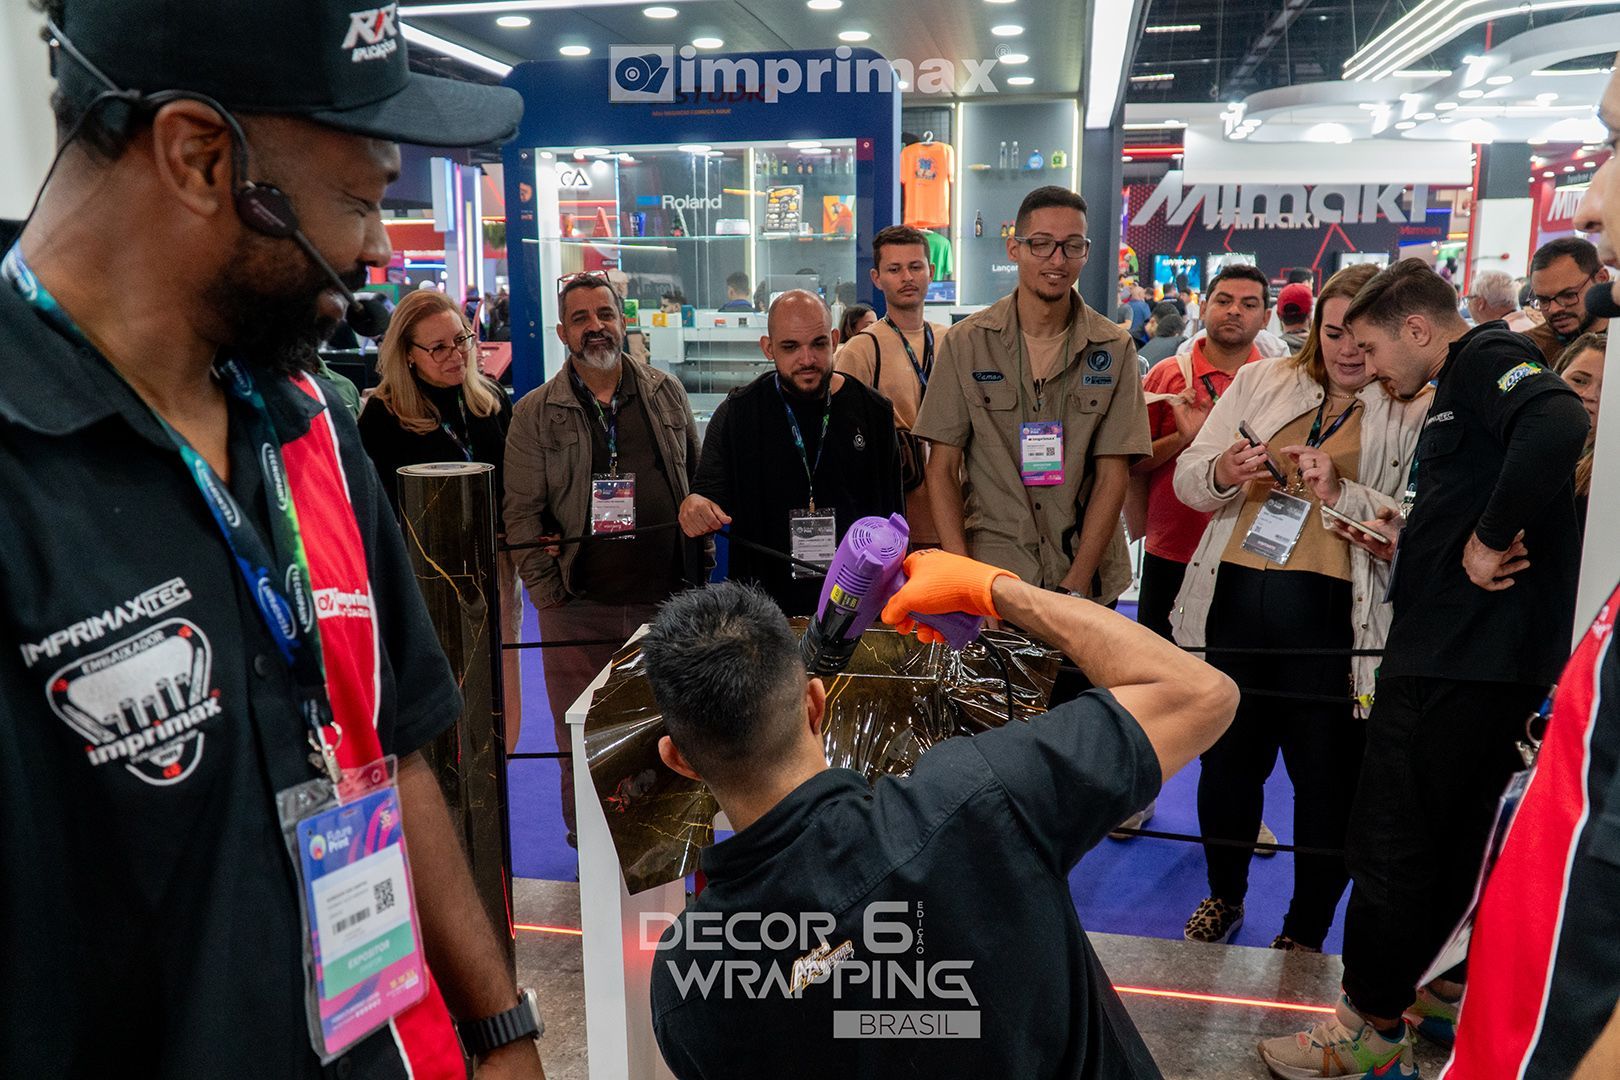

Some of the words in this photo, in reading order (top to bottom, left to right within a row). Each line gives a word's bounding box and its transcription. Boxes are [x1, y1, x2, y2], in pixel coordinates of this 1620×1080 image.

[662, 194, 722, 210] Roland
[1131, 170, 1430, 226] Mimaki
[84, 697, 222, 766] imprimax
